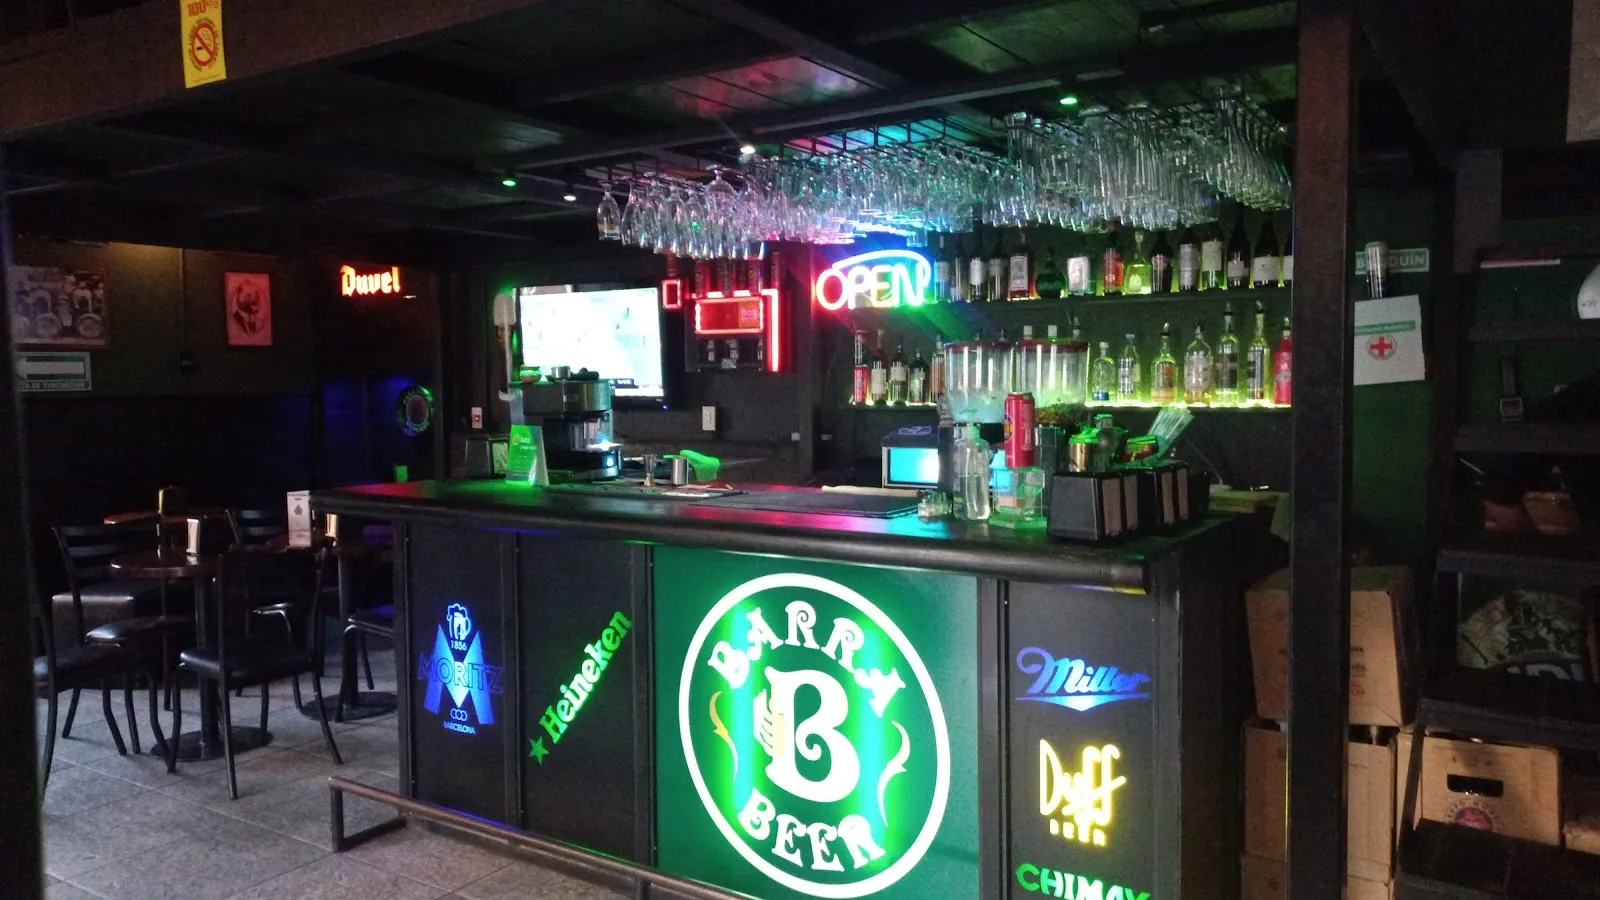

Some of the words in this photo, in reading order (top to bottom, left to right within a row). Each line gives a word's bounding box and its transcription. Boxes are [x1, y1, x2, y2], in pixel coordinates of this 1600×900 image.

[340, 264, 401, 297] Duvel
[815, 259, 930, 311] OPEN
[451, 640, 467, 651] 1856
[707, 600, 907, 719] BARRY
[1016, 646, 1151, 694] Miller
[418, 652, 504, 694] MORITZ
[539, 611, 633, 745] Heineken
[443, 720, 476, 735] BARCELONA
[764, 666, 861, 803] B
[1039, 738, 1127, 826] Duff
[738, 787, 887, 872] BEER
